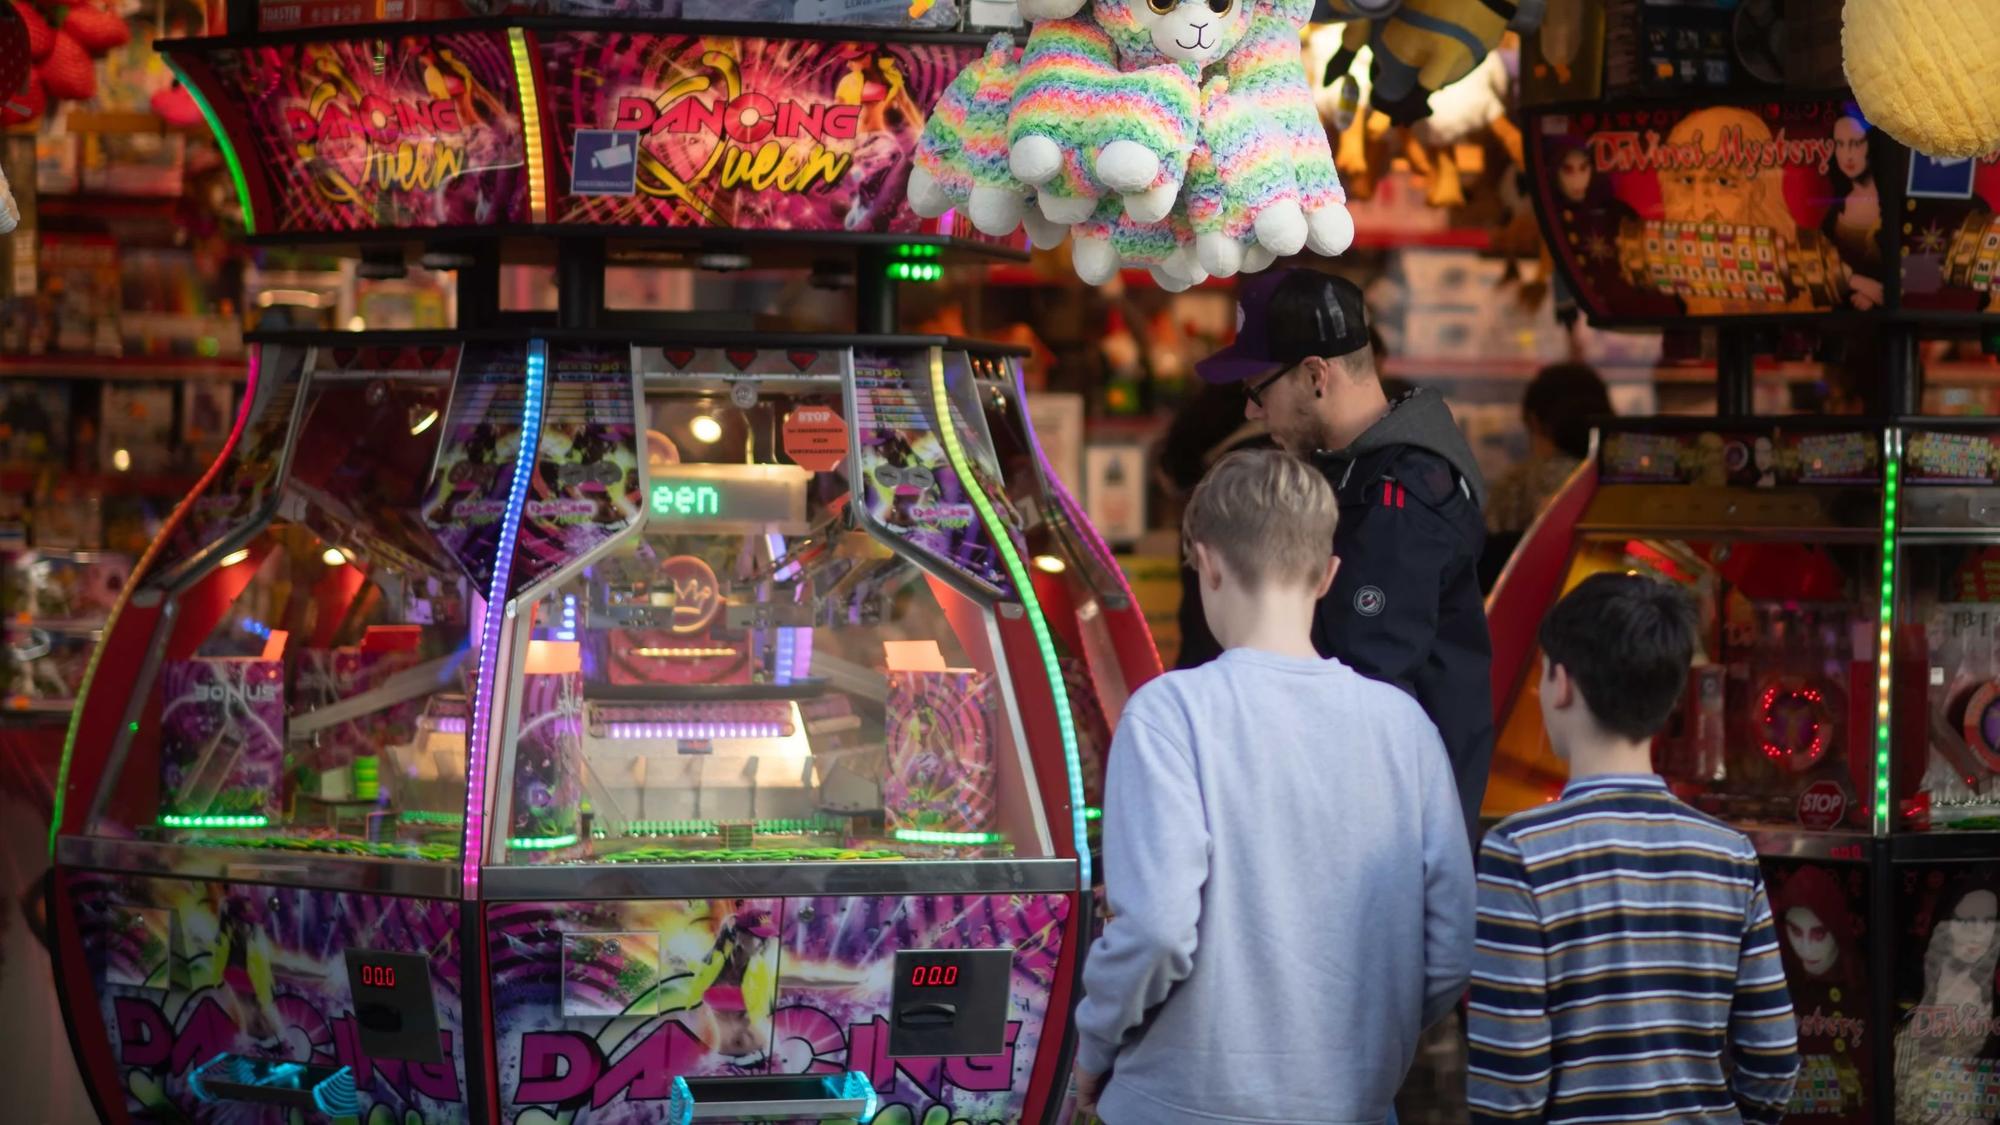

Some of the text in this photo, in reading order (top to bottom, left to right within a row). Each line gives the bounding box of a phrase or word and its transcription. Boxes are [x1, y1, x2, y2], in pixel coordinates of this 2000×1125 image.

[284, 93, 463, 145] DANCING
[614, 92, 862, 143] DANCING
[1585, 124, 1836, 178] DaVinci Mystery
[798, 411, 832, 423] STOP
[652, 486, 718, 515] een
[1801, 793, 1841, 812] STOP
[1800, 1005, 1865, 1048] stery
[1904, 1003, 2000, 1039] DaVinc
